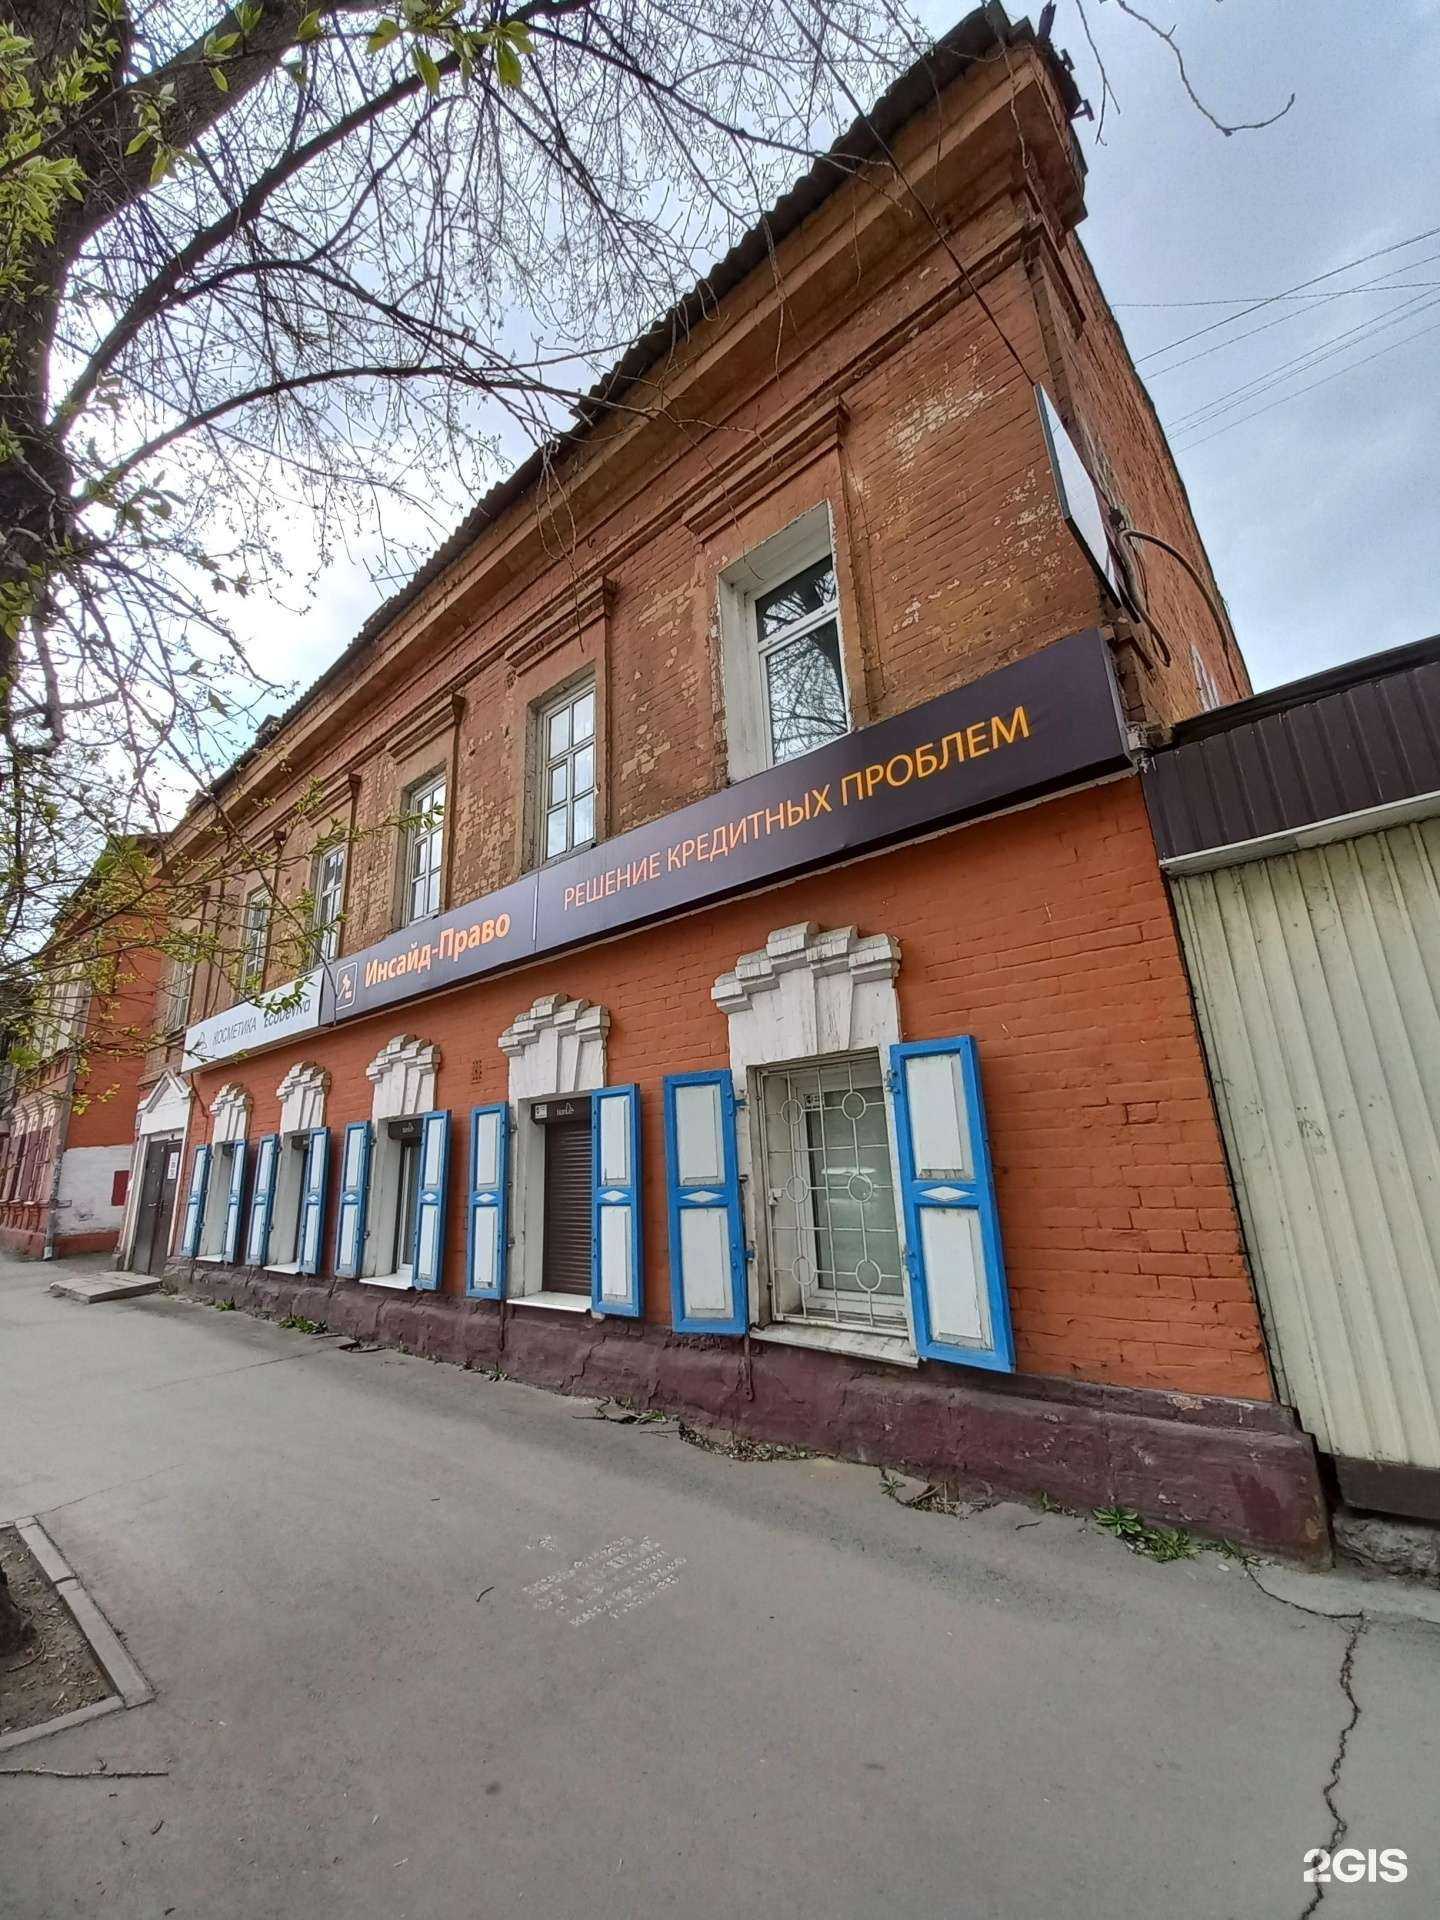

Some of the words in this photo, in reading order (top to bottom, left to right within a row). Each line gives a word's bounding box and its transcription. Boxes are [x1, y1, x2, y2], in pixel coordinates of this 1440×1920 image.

[564, 852, 661, 911] РЕШЕНИЕ
[667, 784, 833, 872] КРЕДИТНЫХ
[841, 705, 1031, 806] ПРОБЛЕМ
[364, 912, 511, 988] Инсайд-Право
[213, 1017, 257, 1046] КОСМЕТИКА
